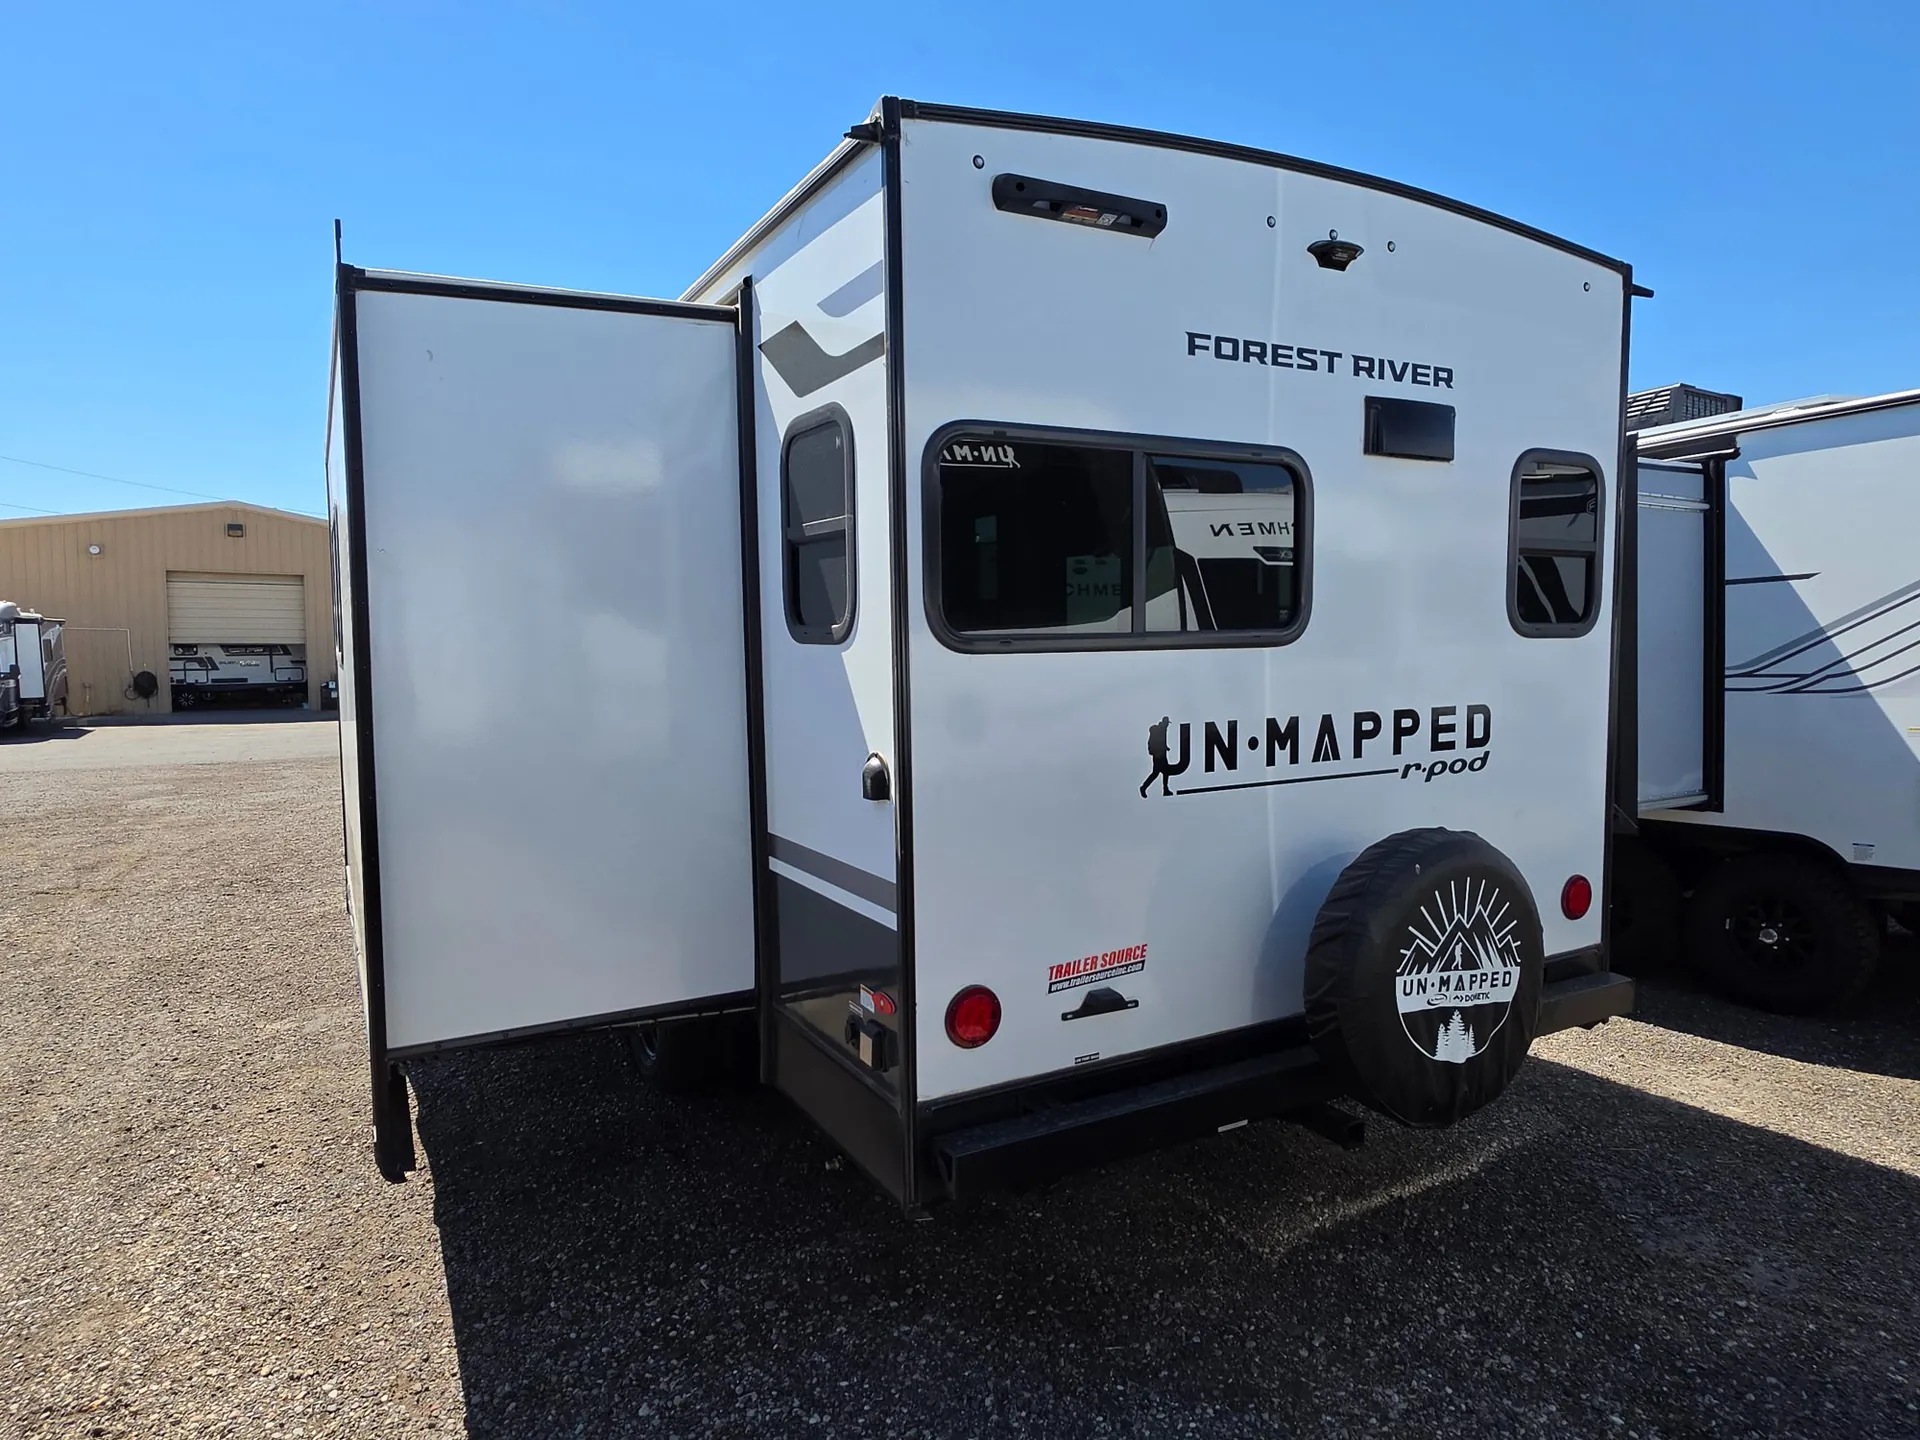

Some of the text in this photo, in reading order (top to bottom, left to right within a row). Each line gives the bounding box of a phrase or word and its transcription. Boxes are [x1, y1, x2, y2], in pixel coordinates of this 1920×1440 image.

[1185, 331, 1455, 389] FOREST RIVER
[1048, 943, 1148, 982] TRAILER SOURCE
